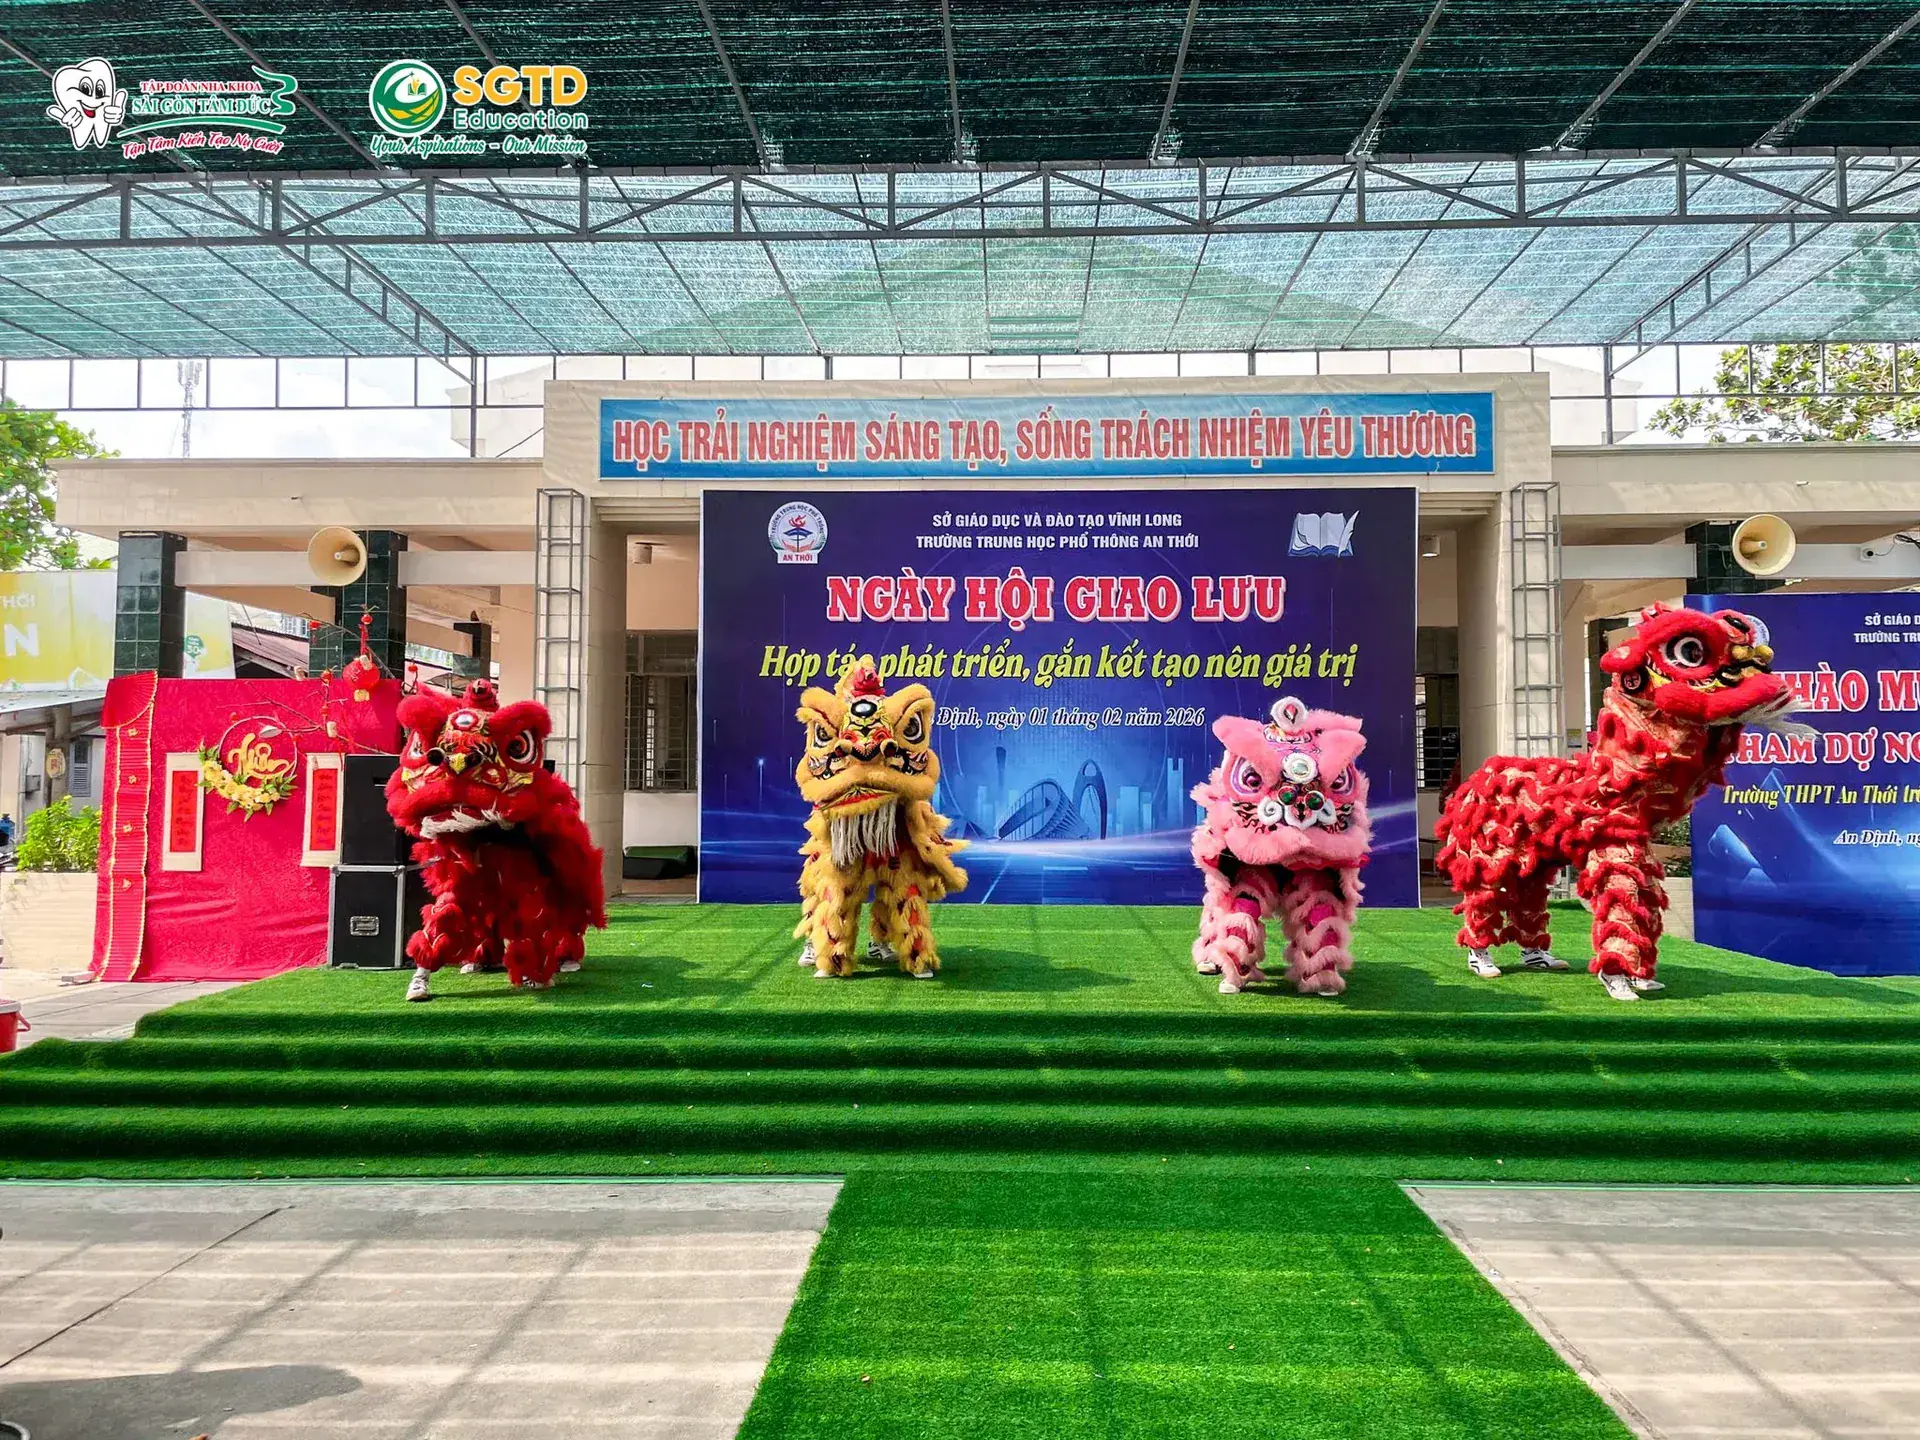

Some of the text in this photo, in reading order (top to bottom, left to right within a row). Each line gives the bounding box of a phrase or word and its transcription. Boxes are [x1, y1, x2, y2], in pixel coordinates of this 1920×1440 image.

[613, 405, 1477, 471] HỌC TRẢI NGHIỆM SÁNG TẠO, SỐNG TRÁCH NHIỆM YÊU THƯƠNG
[933, 511, 1182, 529] SỞ GIÁO DỤC VÀ ĐÀO TẠO VĨNH LONG
[916, 531, 1199, 551] TRƯỜNG TRUNG HỌC PHỔ THÔNG AN THỚI
[783, 554, 793, 562] AN
[826, 566, 1286, 631] NGÀY HỘI GIAO LƯU
[1864, 612, 1881, 626] SỞ
[1883, 613, 1911, 626] GIÁO
[1853, 630, 1900, 643] TRƯỜNG
[759, 637, 1358, 688] Hợp tá phát triển, gắn kết tạo nên giá trị
[1772, 661, 1869, 712] HÀO
[936, 706, 1206, 730] Định, ngày 01 tháng 02 năm 2026
[1725, 732, 1817, 764] HAM
[1823, 726, 1878, 771] DỰ
[1723, 784, 1780, 810] Trường
[1784, 784, 1836, 804] THPT
[1835, 785, 1858, 804] An
[1863, 784, 1898, 804] Thới
[1833, 829, 1858, 844] An
[1860, 829, 1903, 847] Định,
